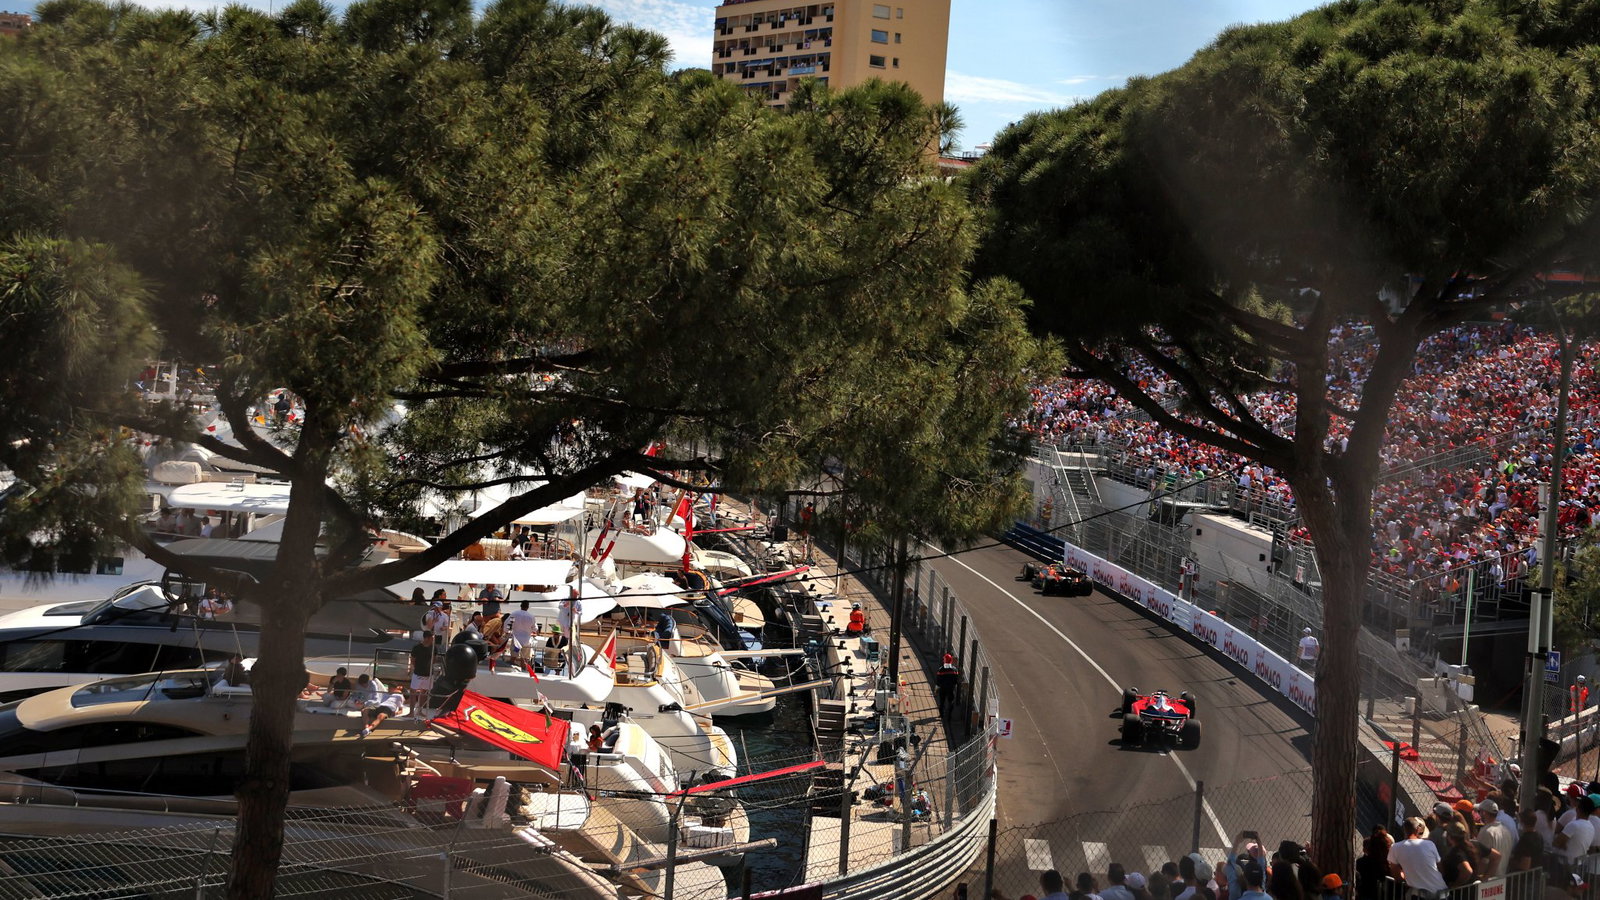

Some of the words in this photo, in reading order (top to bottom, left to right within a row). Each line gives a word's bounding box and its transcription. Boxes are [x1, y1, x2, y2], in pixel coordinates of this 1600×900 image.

[1093, 568, 1114, 587] MONACO
[1120, 582, 1141, 602] MONACO
[1147, 595, 1169, 618] MONACO
[1193, 621, 1217, 645] MONACO
[1223, 639, 1248, 666] MONACO
[1255, 659, 1280, 689] MONACO
[1481, 884, 1504, 898] TRIBUNE
